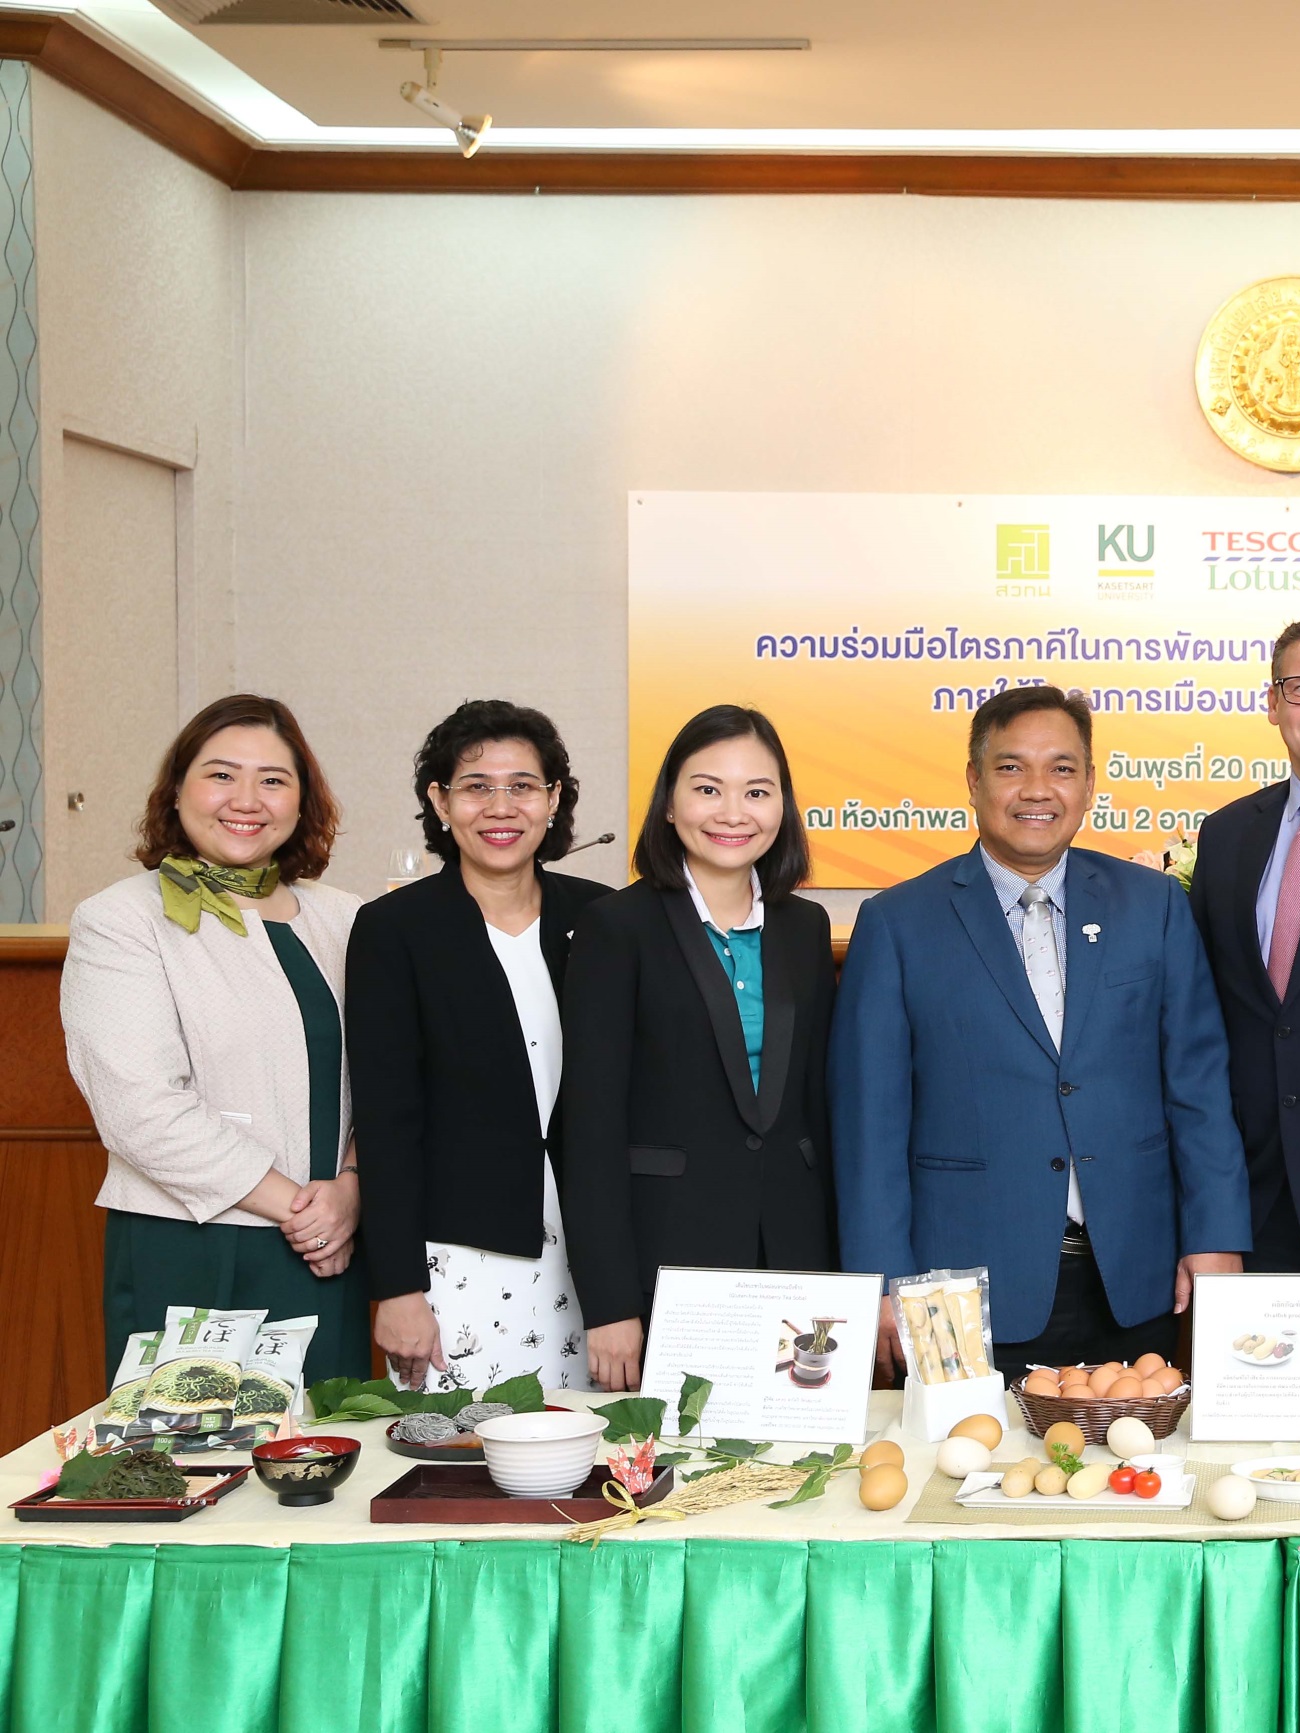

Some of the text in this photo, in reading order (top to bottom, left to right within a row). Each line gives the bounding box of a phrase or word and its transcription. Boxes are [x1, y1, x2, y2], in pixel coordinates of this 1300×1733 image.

[1098, 524, 1154, 562] KU
[995, 584, 1051, 598] สวทน
[1097, 582, 1154, 591] KASETSART
[1097, 592, 1154, 602] UNIVERSITY
[1108, 745, 1201, 788] วันพุธที่
[1210, 758, 1243, 779] 20
[1251, 760, 1290, 788] กุม
[807, 809, 833, 828] ณ
[842, 801, 967, 828] ห้องกำพล
[1092, 795, 1126, 830] ชั้น
[1135, 808, 1151, 830] 2
[1159, 811, 1209, 830] อาค
[203, 1317, 237, 1343] そば
[255, 1331, 288, 1355] そば
